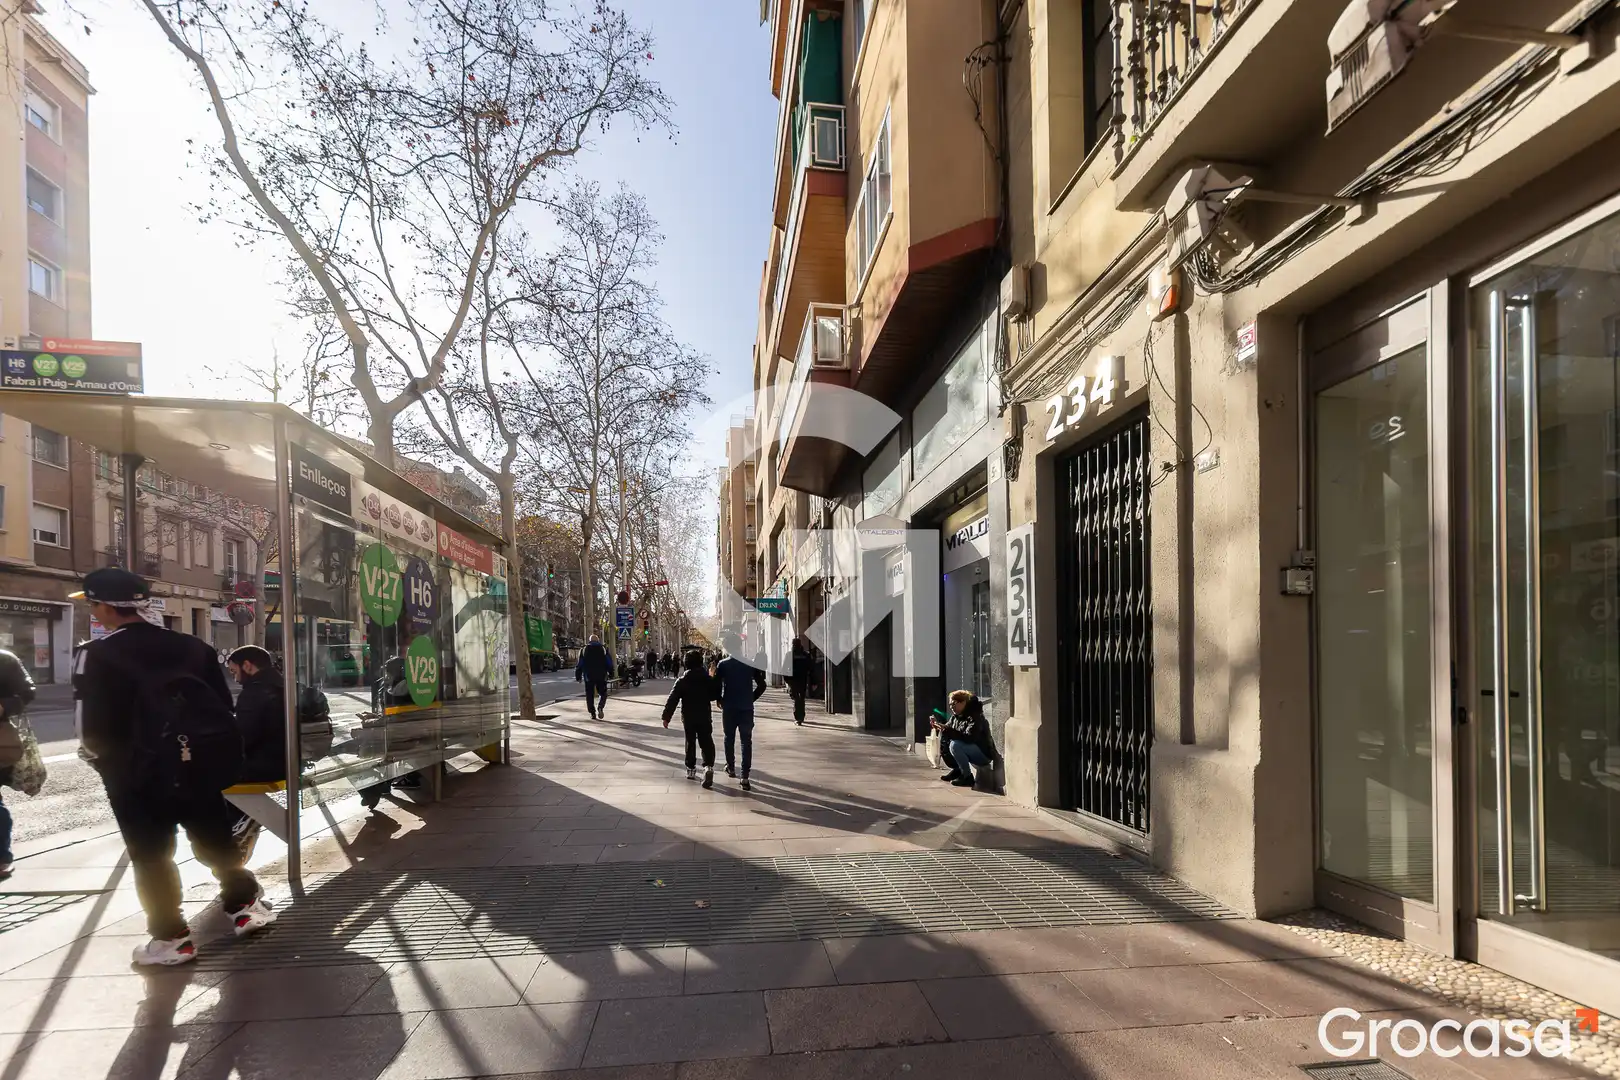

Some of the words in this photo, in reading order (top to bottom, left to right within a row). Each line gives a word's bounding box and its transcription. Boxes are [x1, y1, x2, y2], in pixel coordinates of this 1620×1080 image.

[8, 358, 26, 368] H6
[33, 360, 58, 370] V27
[4, 376, 36, 386] Fabra
[108, 380, 143, 392] d'Oms
[1044, 356, 1119, 442] 234
[299, 460, 347, 498] Enllaços
[362, 562, 400, 601] V27
[410, 576, 432, 608] H6
[1010, 537, 1027, 655] 234
[13, 603, 52, 614] D'UNGLES
[408, 655, 437, 684] V29
